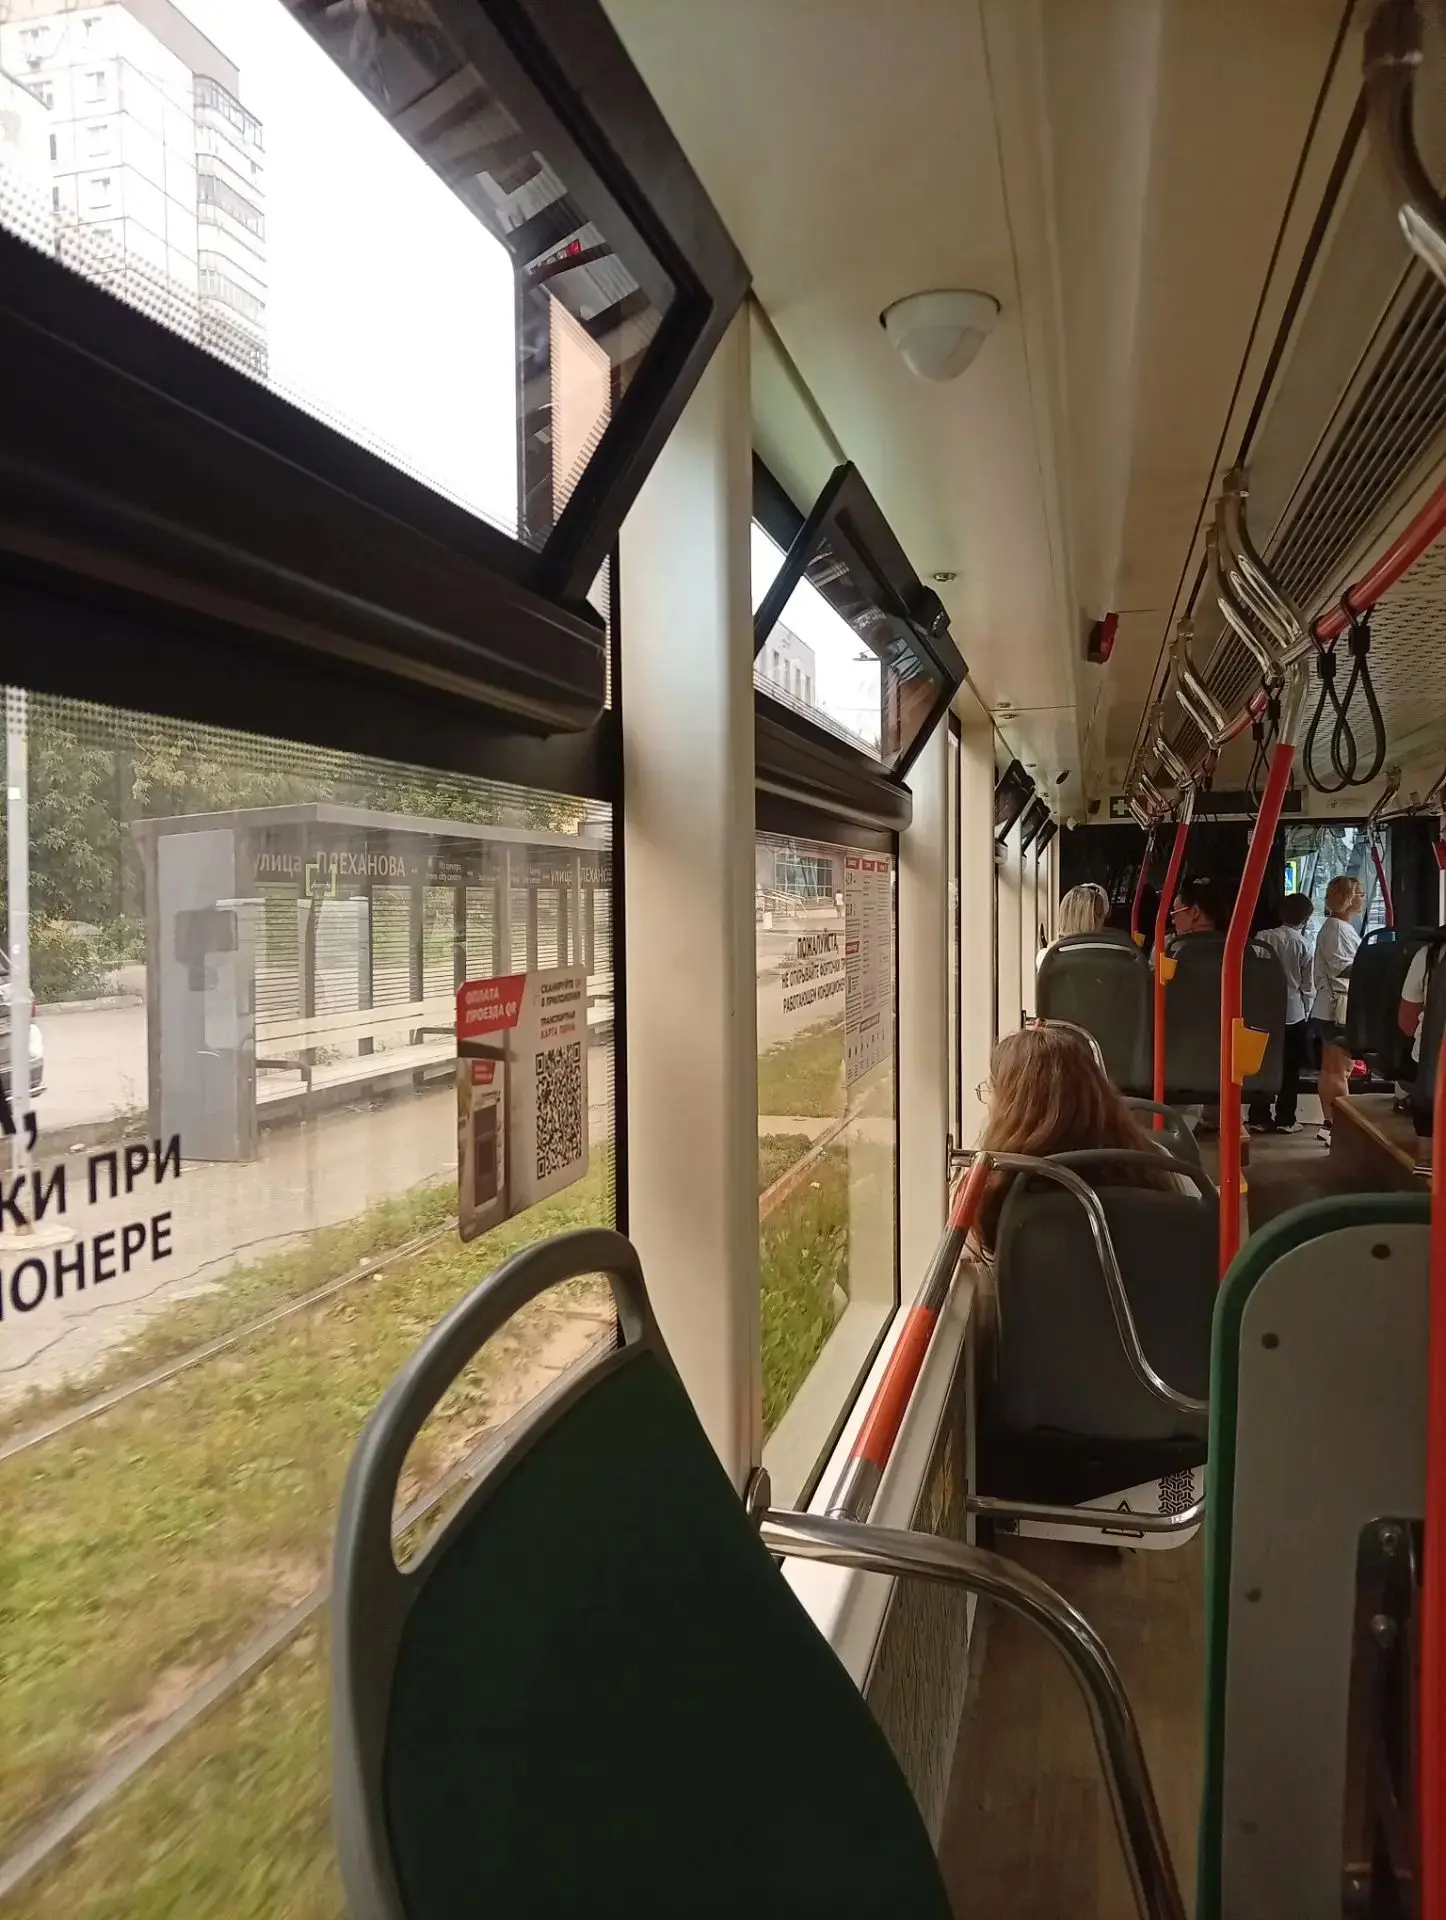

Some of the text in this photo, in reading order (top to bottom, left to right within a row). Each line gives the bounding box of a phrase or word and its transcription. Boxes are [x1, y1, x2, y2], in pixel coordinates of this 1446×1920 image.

[316, 852, 406, 877] ПЛЕХАНОВА
[466, 1004, 504, 1023] ПРОЕЗДА
[88, 1133, 181, 1204] ПРИ
[0, 1211, 172, 1321] ОНЕРЕ
